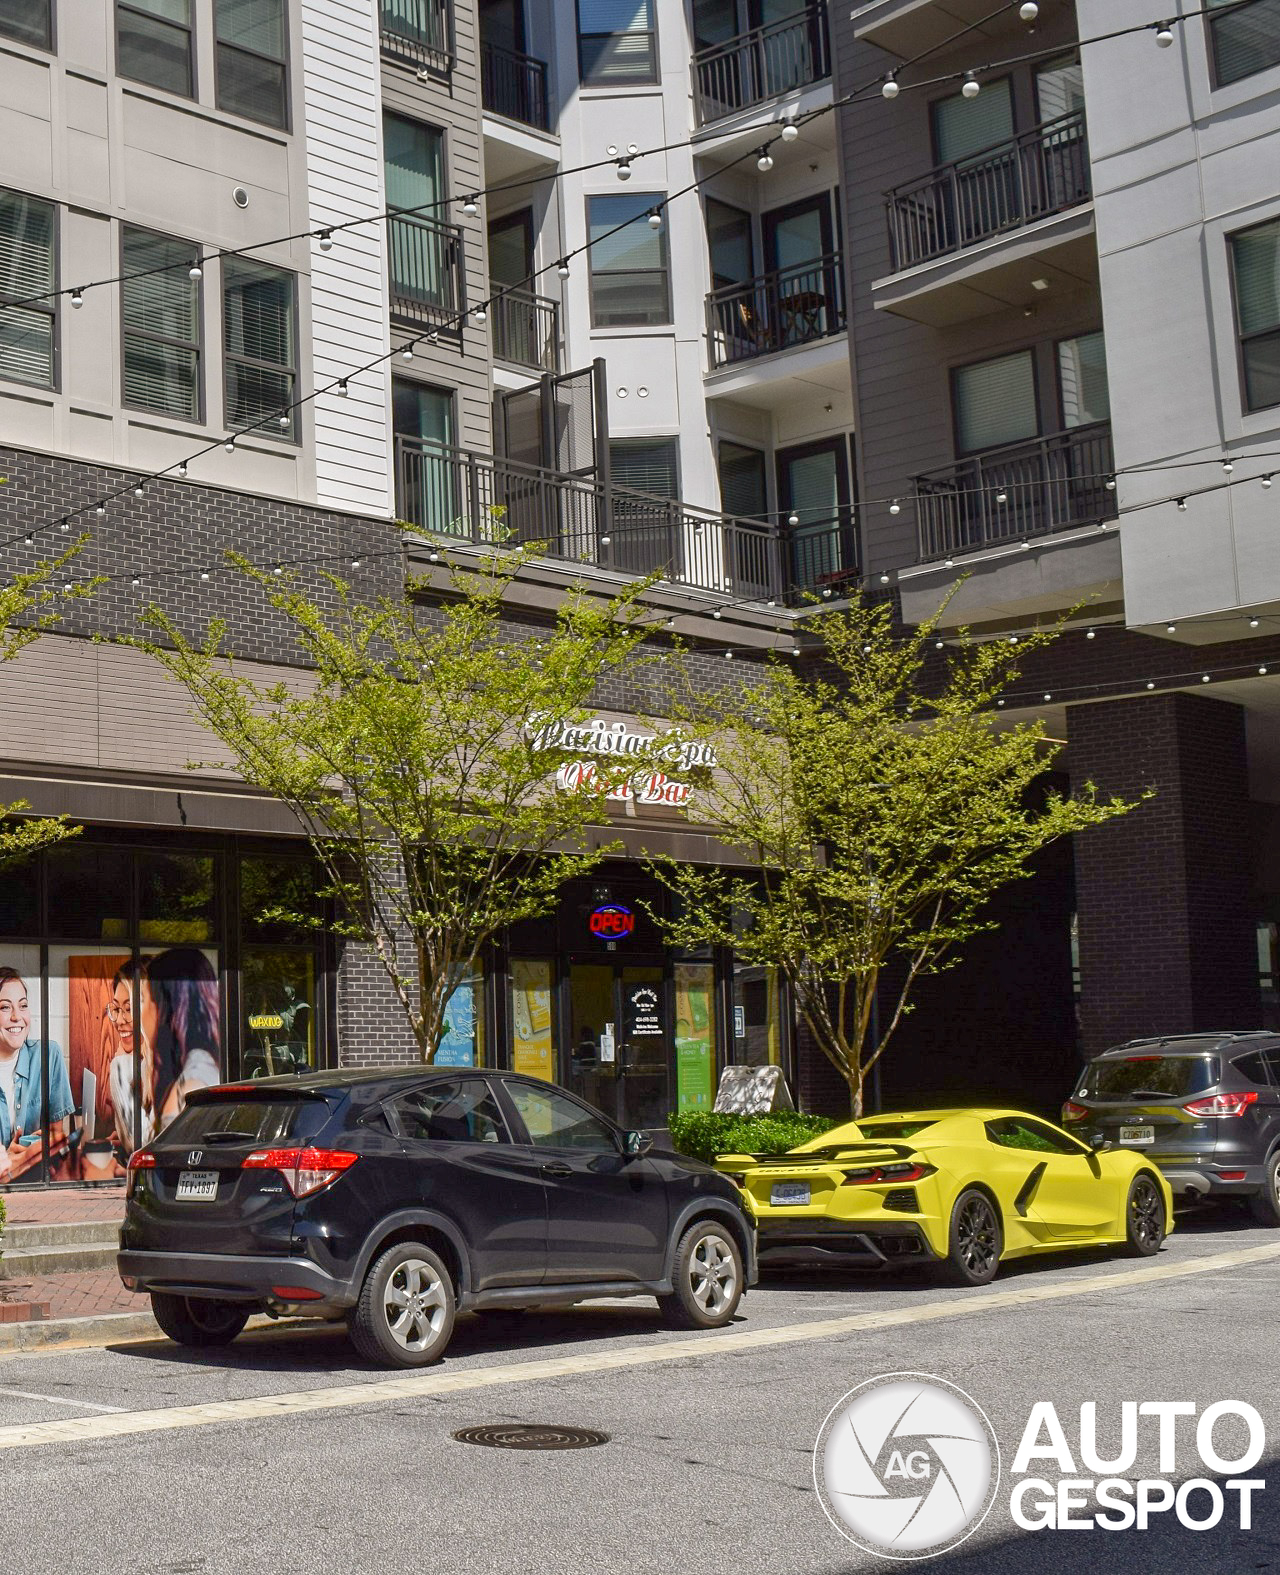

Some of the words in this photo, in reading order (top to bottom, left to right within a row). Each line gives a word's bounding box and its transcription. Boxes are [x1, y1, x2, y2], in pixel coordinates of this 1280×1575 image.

[634, 771, 694, 806] Bar
[590, 913, 634, 932] OPEN
[251, 1016, 282, 1027] WAXING
